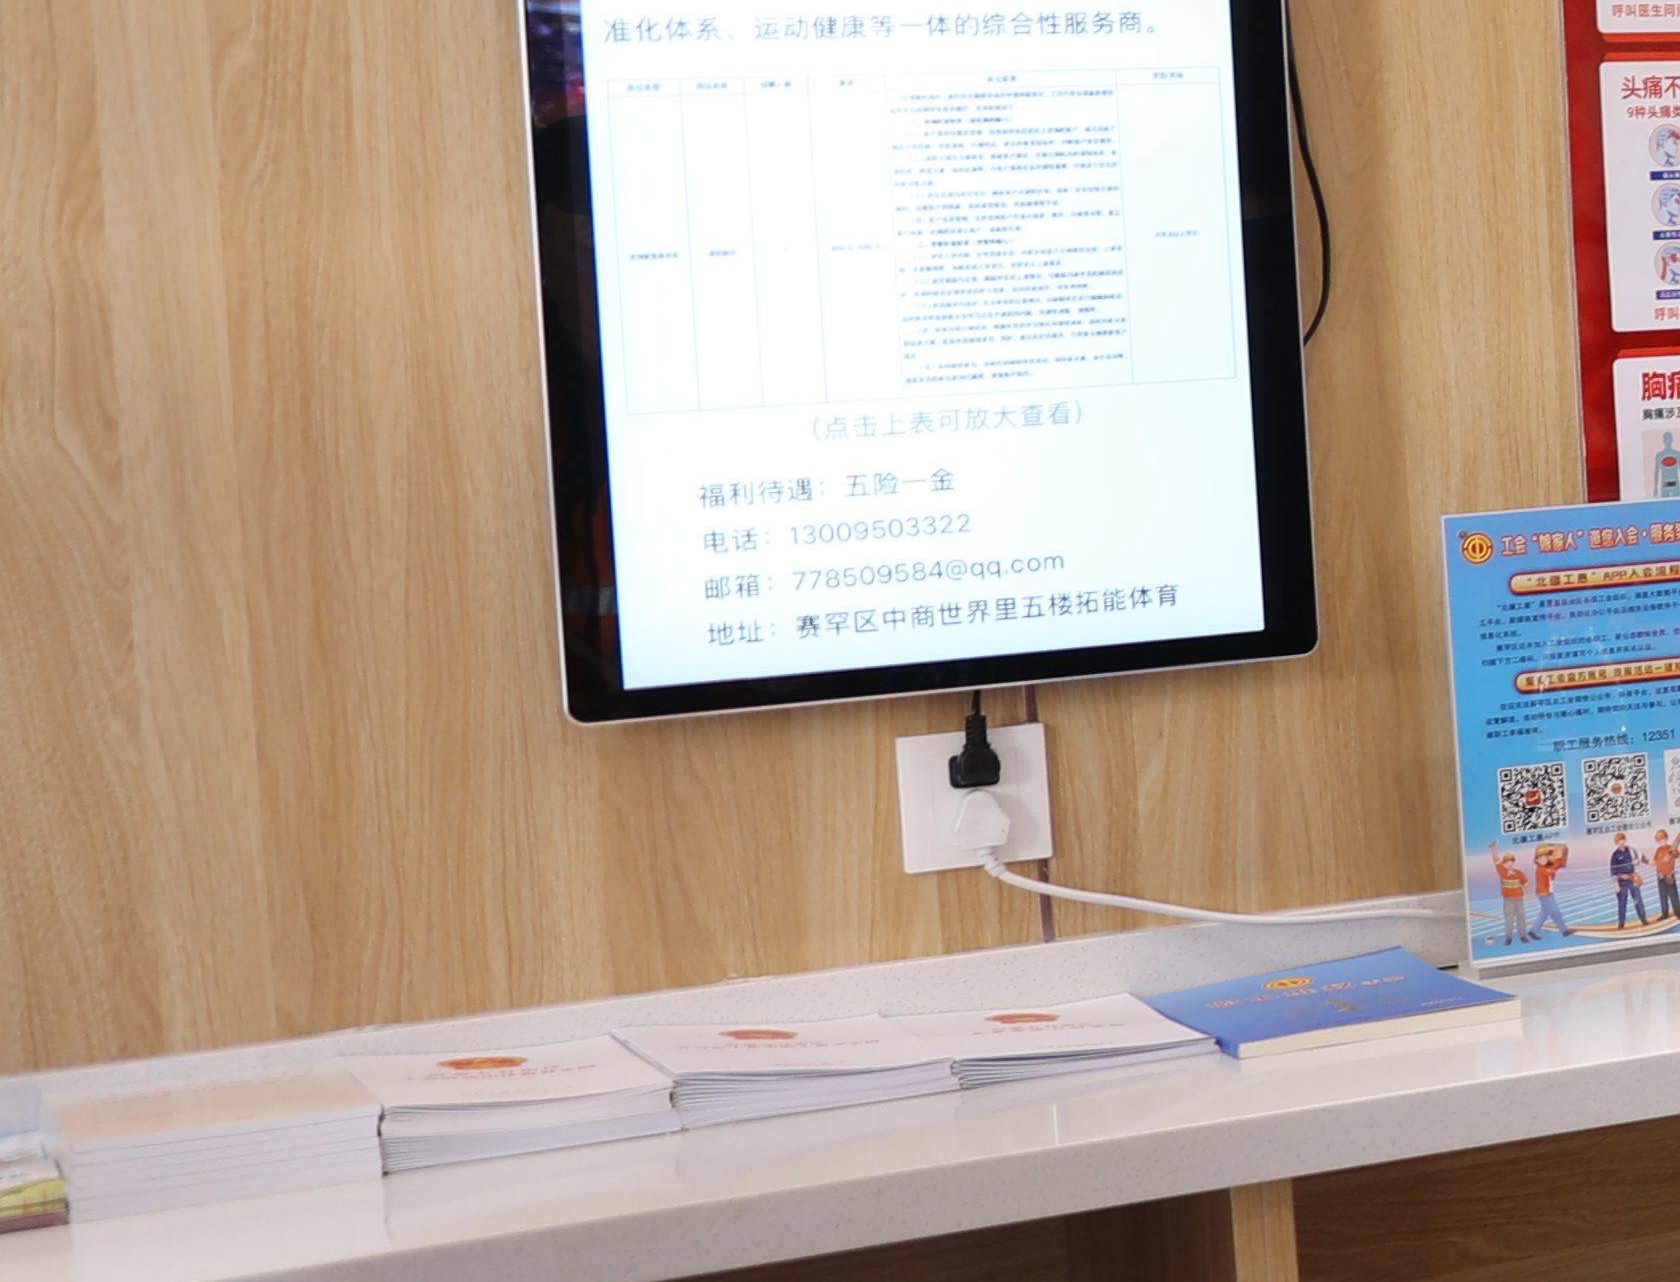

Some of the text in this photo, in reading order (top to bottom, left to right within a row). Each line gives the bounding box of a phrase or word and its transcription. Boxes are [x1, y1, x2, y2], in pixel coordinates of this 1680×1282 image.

[699, 468, 955, 509] 福利待遇：五险一金
